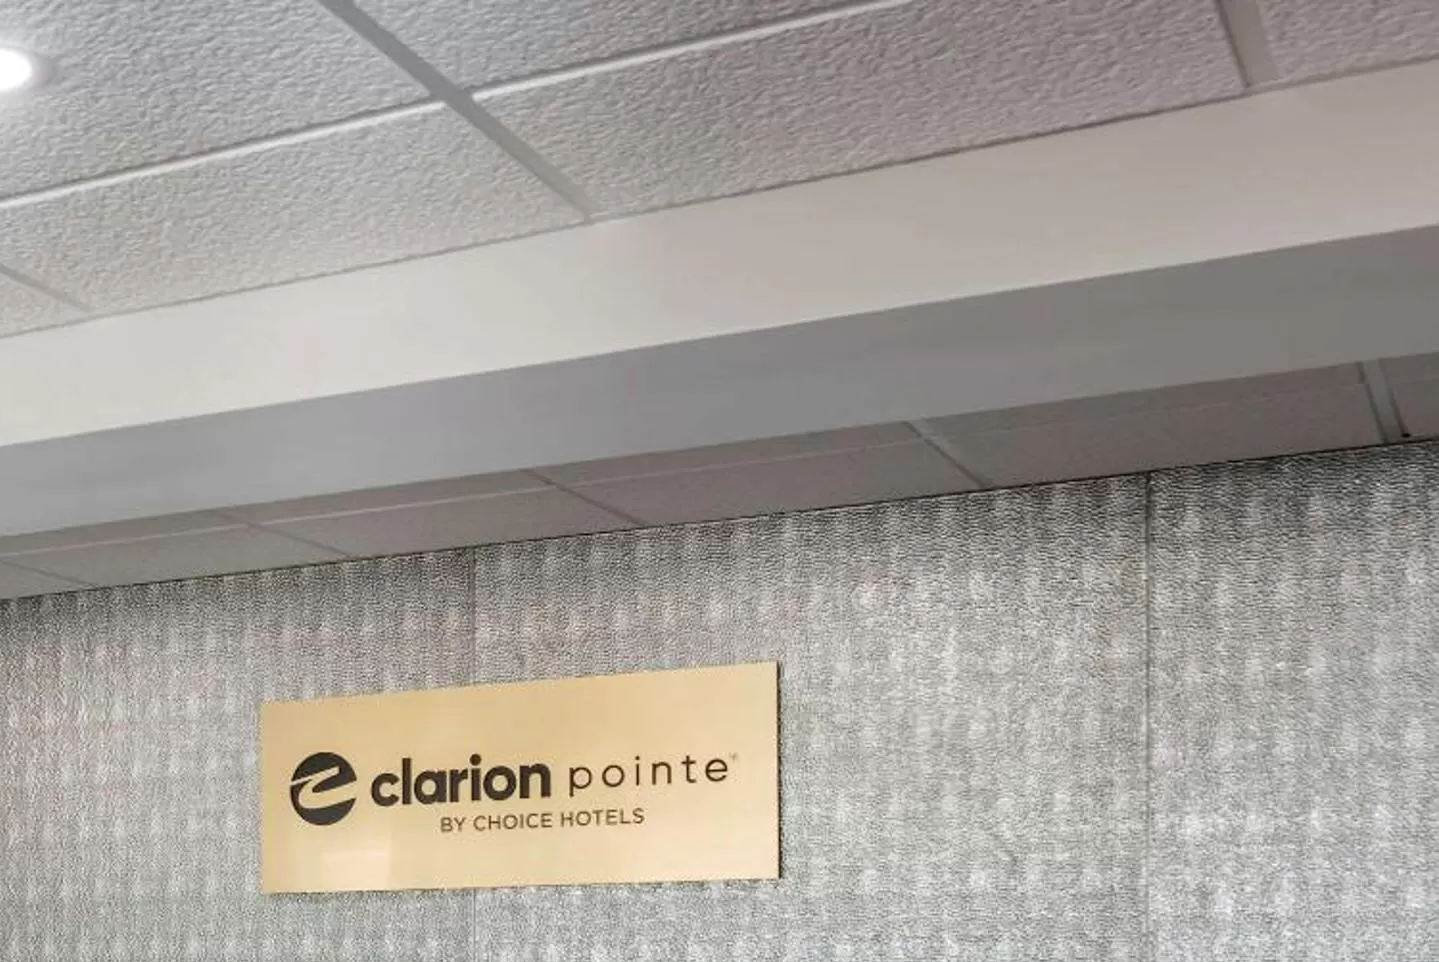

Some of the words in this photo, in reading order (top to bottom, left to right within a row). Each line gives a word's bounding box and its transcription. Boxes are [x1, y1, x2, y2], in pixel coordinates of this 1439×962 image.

[371, 754, 552, 807] clarion
[569, 755, 728, 797] pointe
[440, 815, 464, 833] BY
[472, 811, 553, 832] CHOICE
[561, 807, 645, 828] HOTELS
